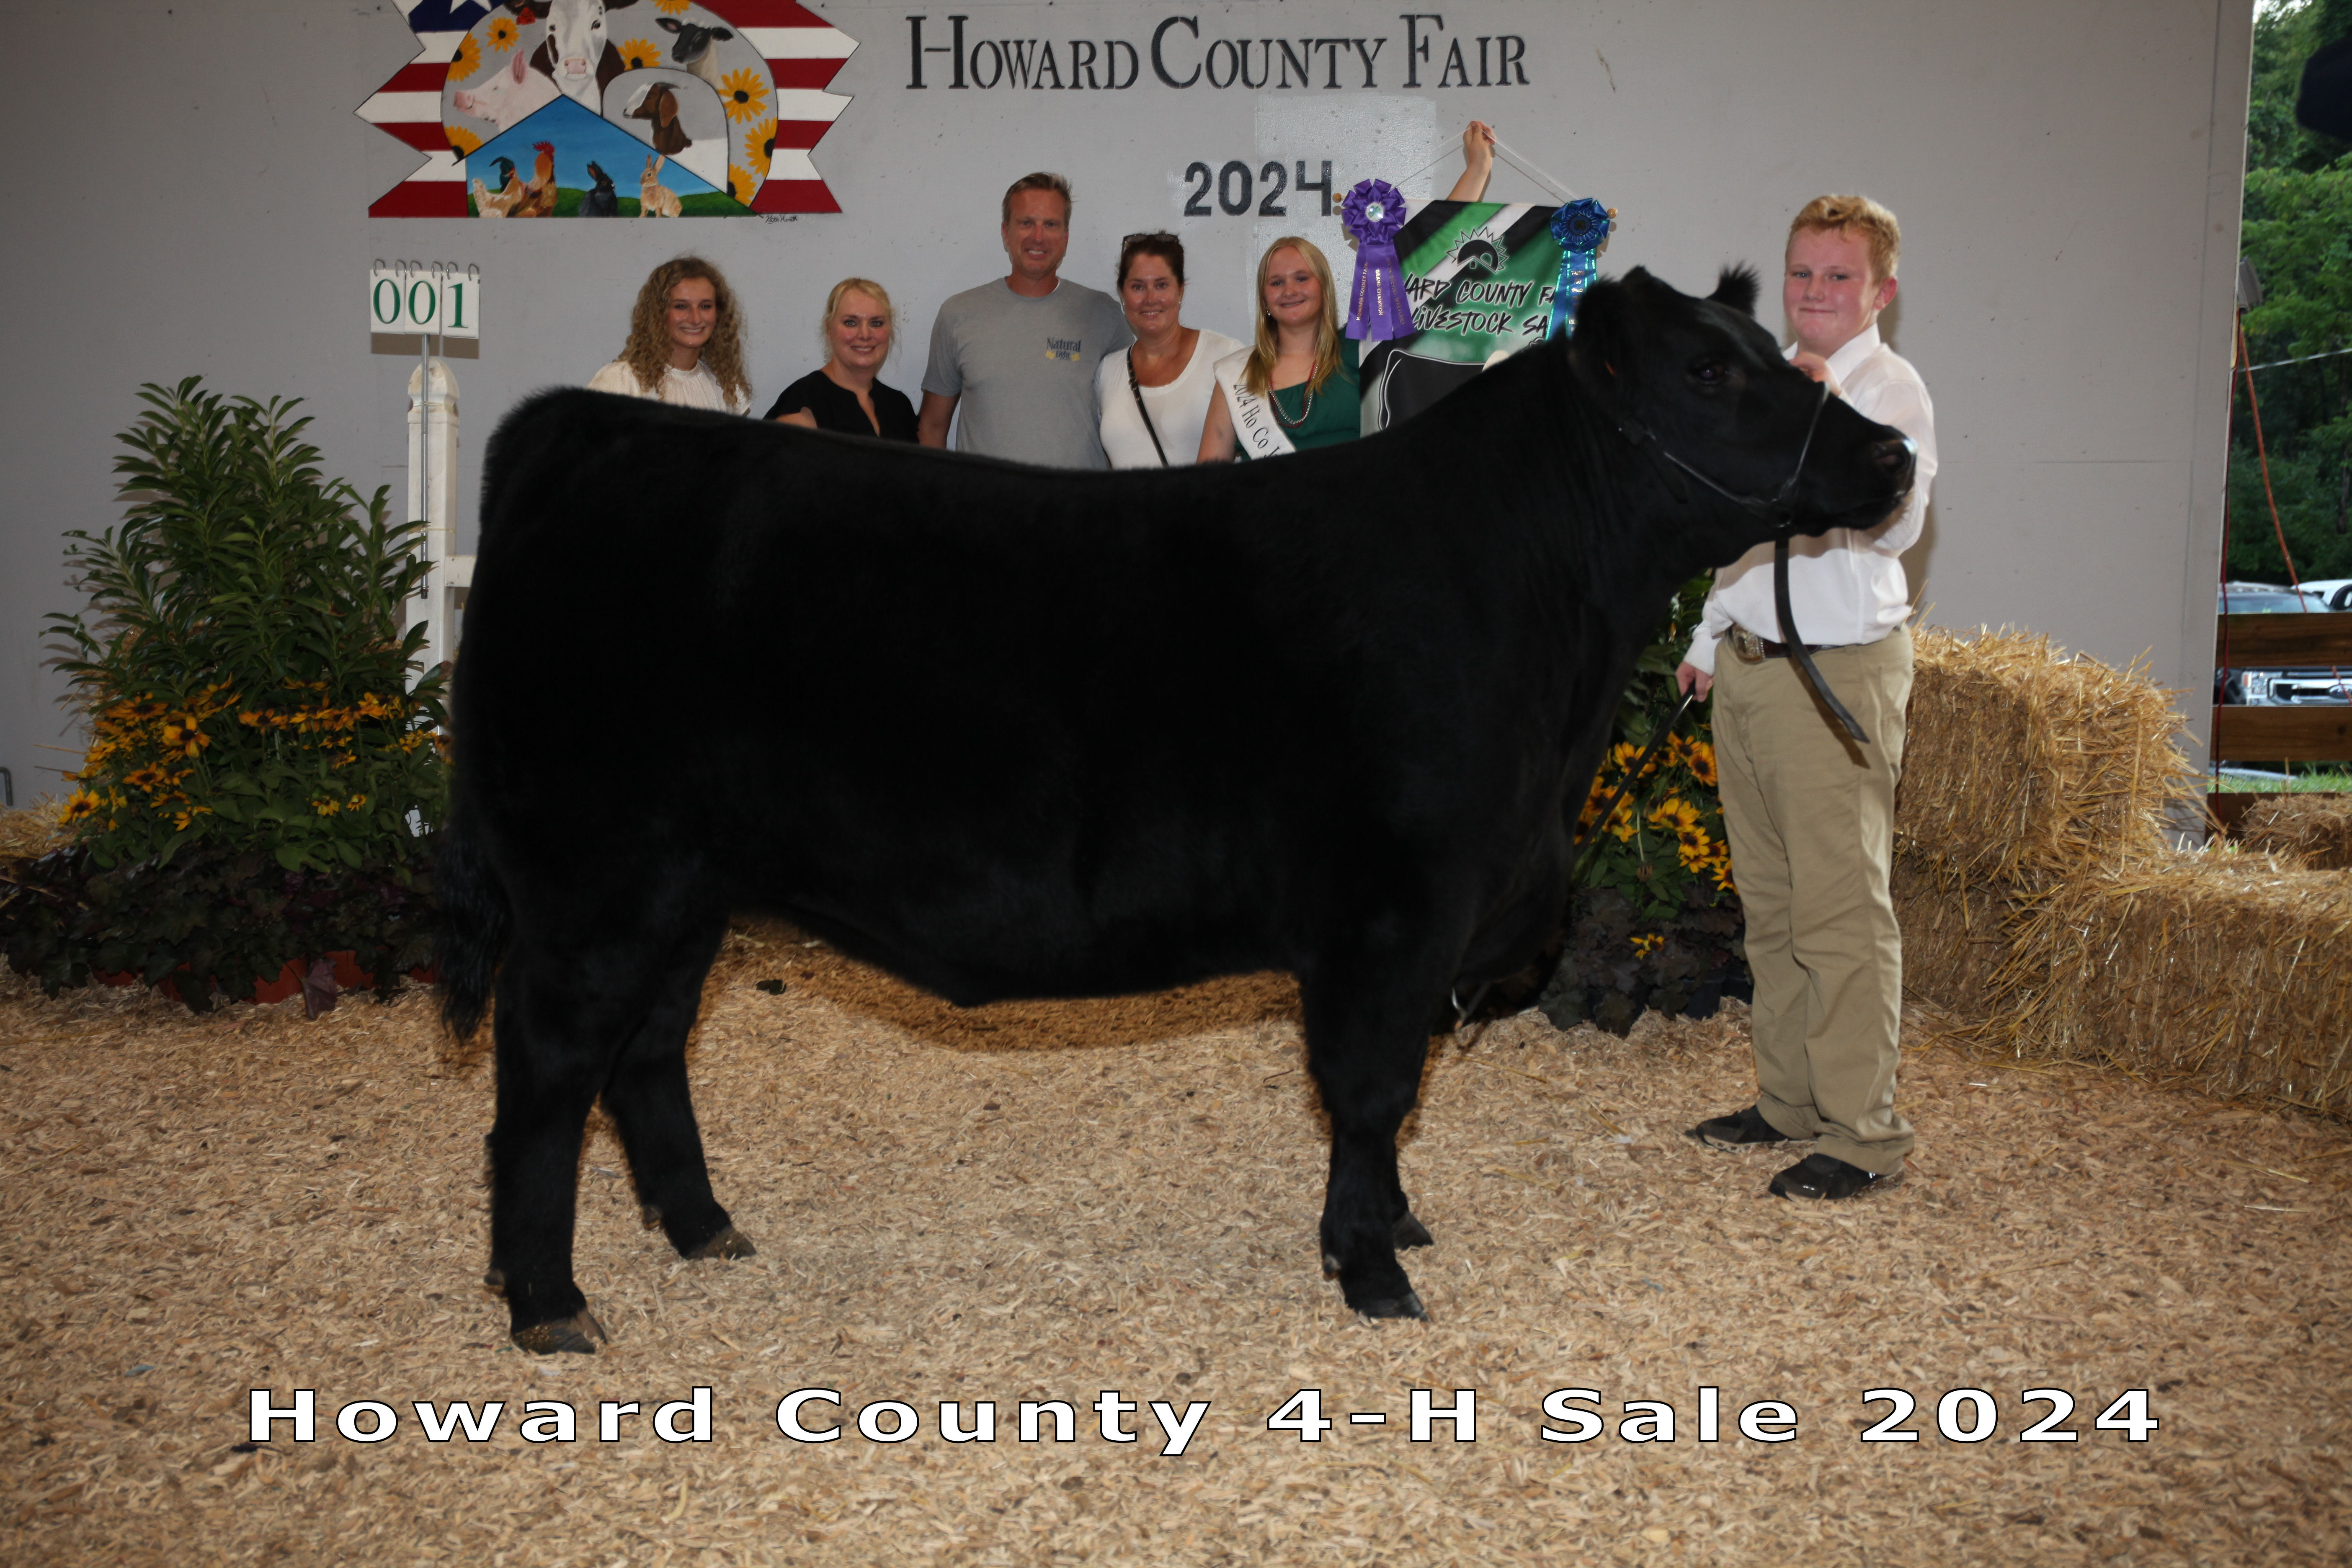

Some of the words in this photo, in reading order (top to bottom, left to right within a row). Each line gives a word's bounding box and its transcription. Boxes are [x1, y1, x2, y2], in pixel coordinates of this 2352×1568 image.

[905, 15, 1139, 90] HOWARD
[1150, 15, 1387, 90] COUNTY
[1399, 14, 1530, 88] FAIR
[1184, 160, 1332, 217] 2024
[373, 279, 469, 329] 001
[1456, 281, 1534, 308] COUNTY
[1047, 338, 1081, 353] Natural
[1242, 405, 1260, 428] Ho
[1253, 427, 1268, 449] Co
